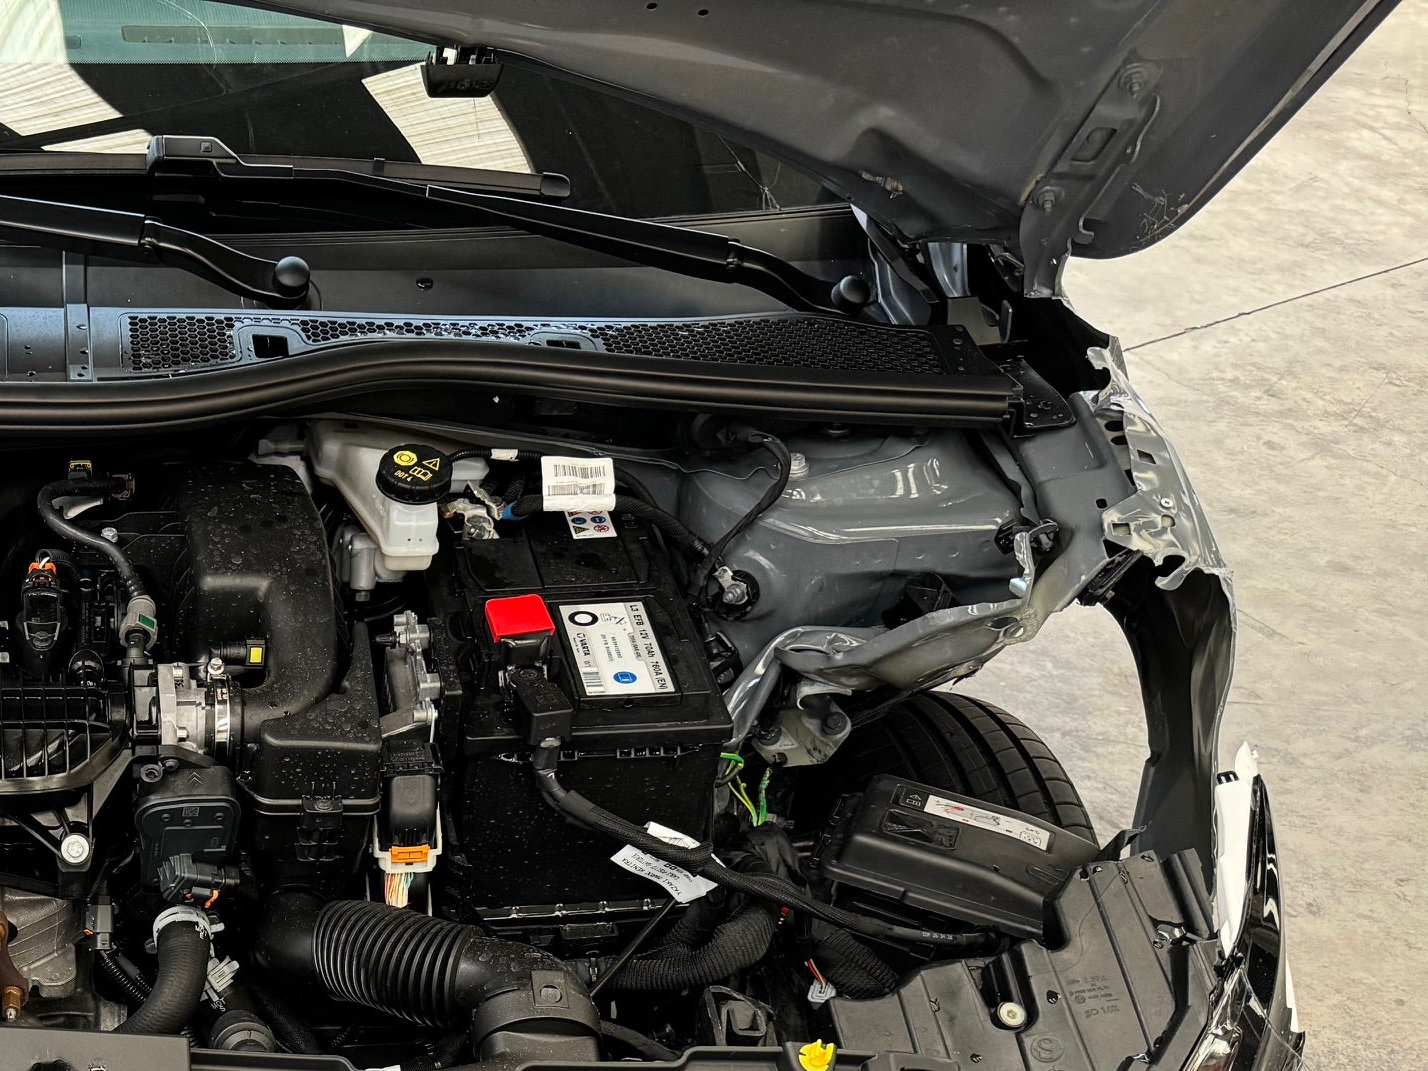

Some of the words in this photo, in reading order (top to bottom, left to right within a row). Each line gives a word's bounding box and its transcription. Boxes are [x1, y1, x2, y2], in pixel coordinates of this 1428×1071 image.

[395, 470, 409, 479] DOT
[629, 604, 639, 612] L3
[633, 614, 644, 626] EFB
[639, 629, 650, 640] 12V
[580, 638, 591, 656] VARTA
[644, 643, 655, 658] 70Ah
[650, 661, 663, 676] 760A
[657, 677, 668, 690] (EN)
